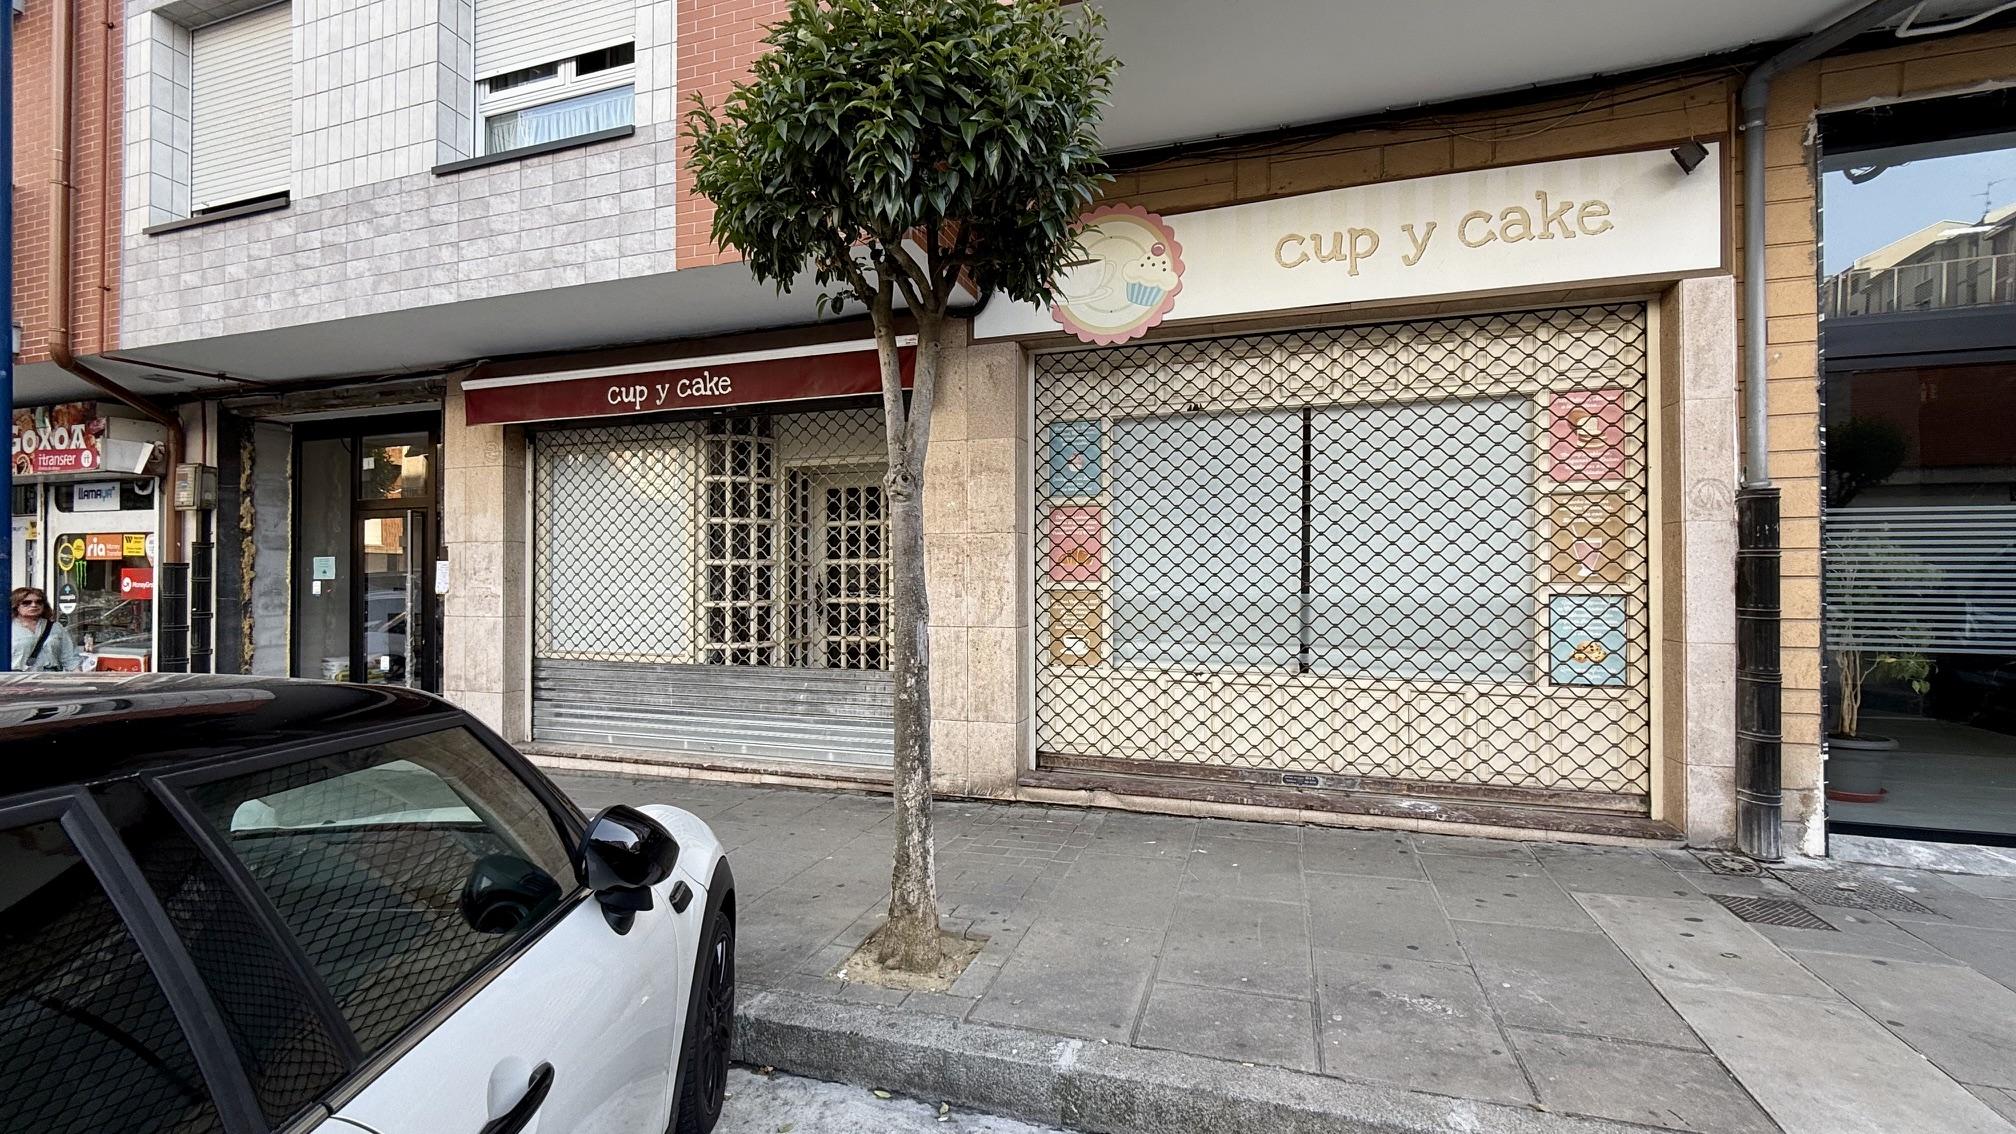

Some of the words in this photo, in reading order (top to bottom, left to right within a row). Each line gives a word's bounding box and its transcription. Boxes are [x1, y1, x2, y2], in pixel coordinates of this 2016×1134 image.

[1274, 226, 1380, 277] cup
[1401, 221, 1438, 267] y
[1457, 190, 1615, 249] cake
[607, 385, 648, 410] cup
[656, 383, 670, 406] y
[677, 370, 732, 398] cake
[87, 536, 106, 557] ria
